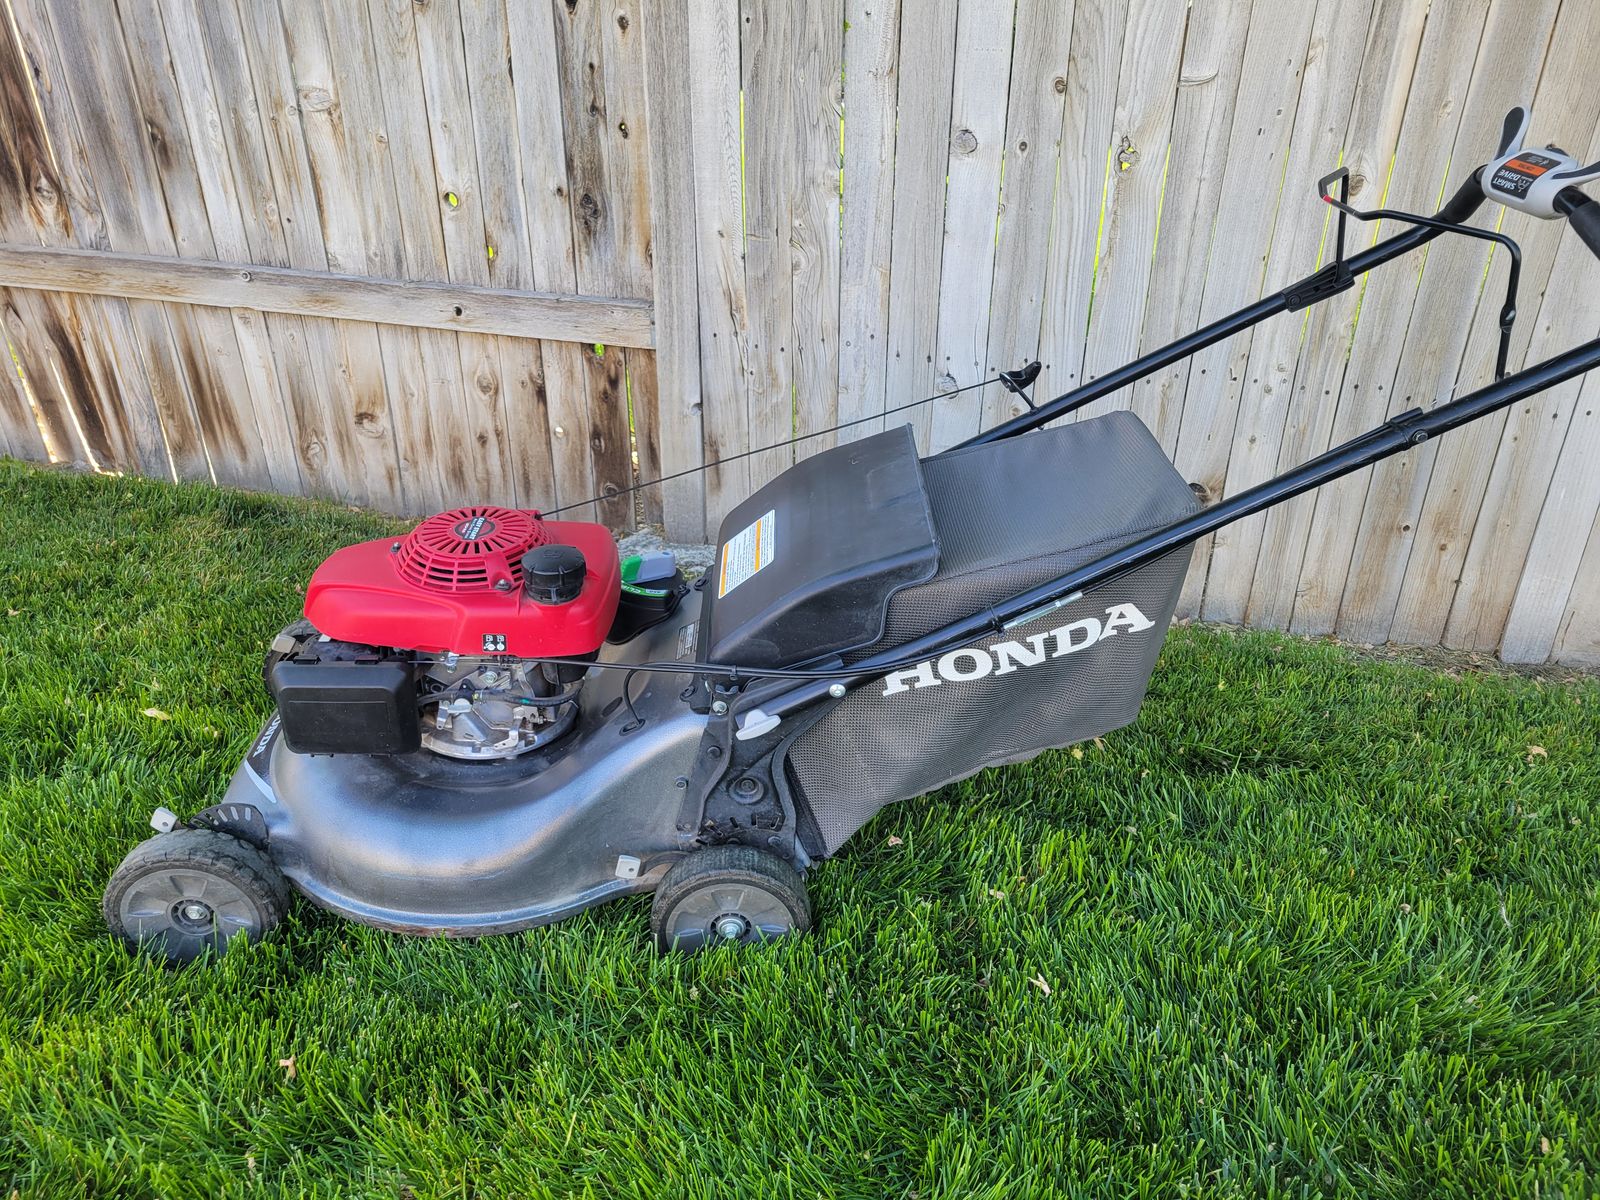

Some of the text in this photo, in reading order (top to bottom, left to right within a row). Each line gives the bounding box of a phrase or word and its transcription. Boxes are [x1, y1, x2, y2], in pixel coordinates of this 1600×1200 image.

[1493, 177, 1517, 190] SMART
[1498, 169, 1521, 181] DRIVE
[883, 603, 1156, 697] HONDA
[253, 714, 281, 757] ONDA
